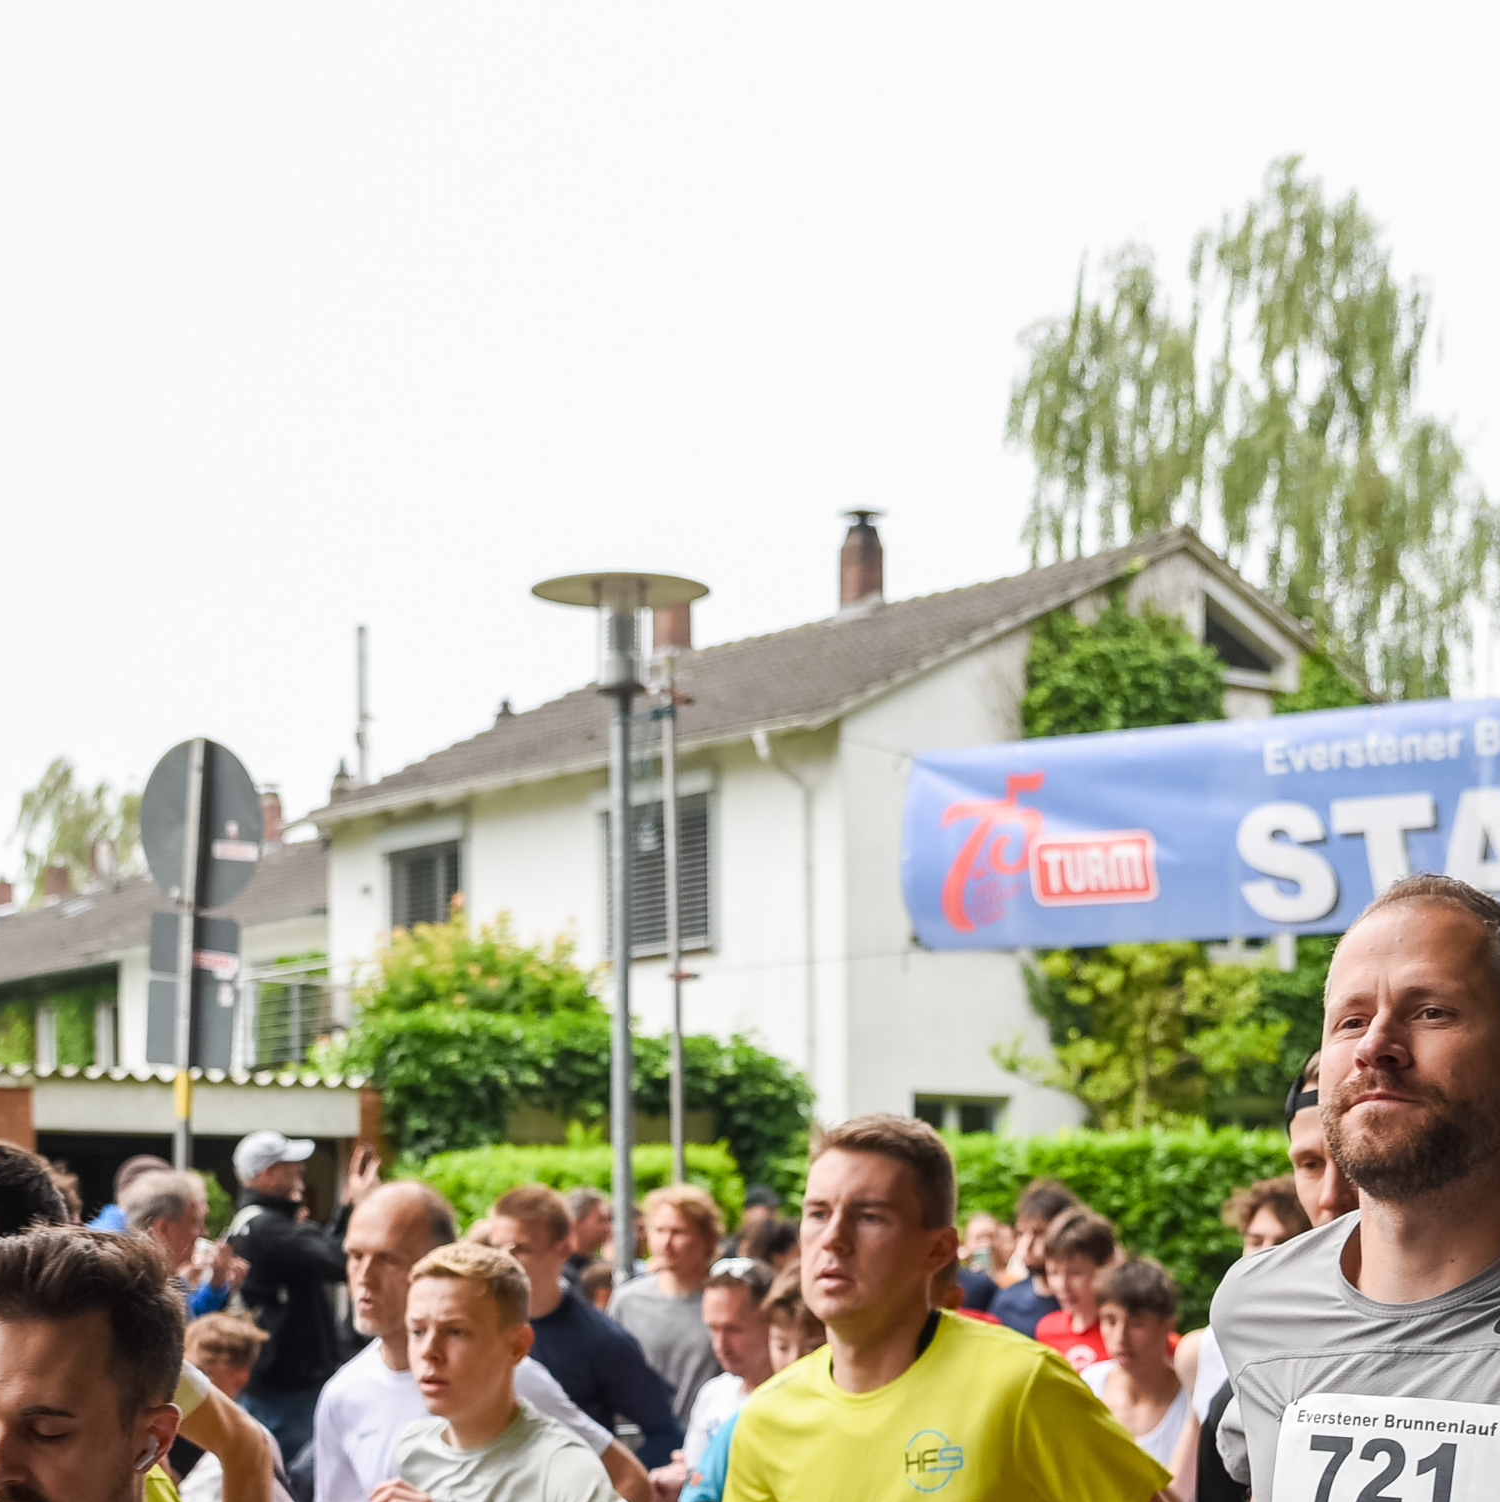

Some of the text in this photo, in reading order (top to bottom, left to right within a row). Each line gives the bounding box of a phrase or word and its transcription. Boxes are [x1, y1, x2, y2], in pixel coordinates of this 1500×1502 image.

[1264, 728, 1464, 776] Everstener
[1041, 844, 1148, 894] TURM
[1297, 1409, 1499, 1437] Everstener Brunnenlauf
[905, 1446, 964, 1474] HFS
